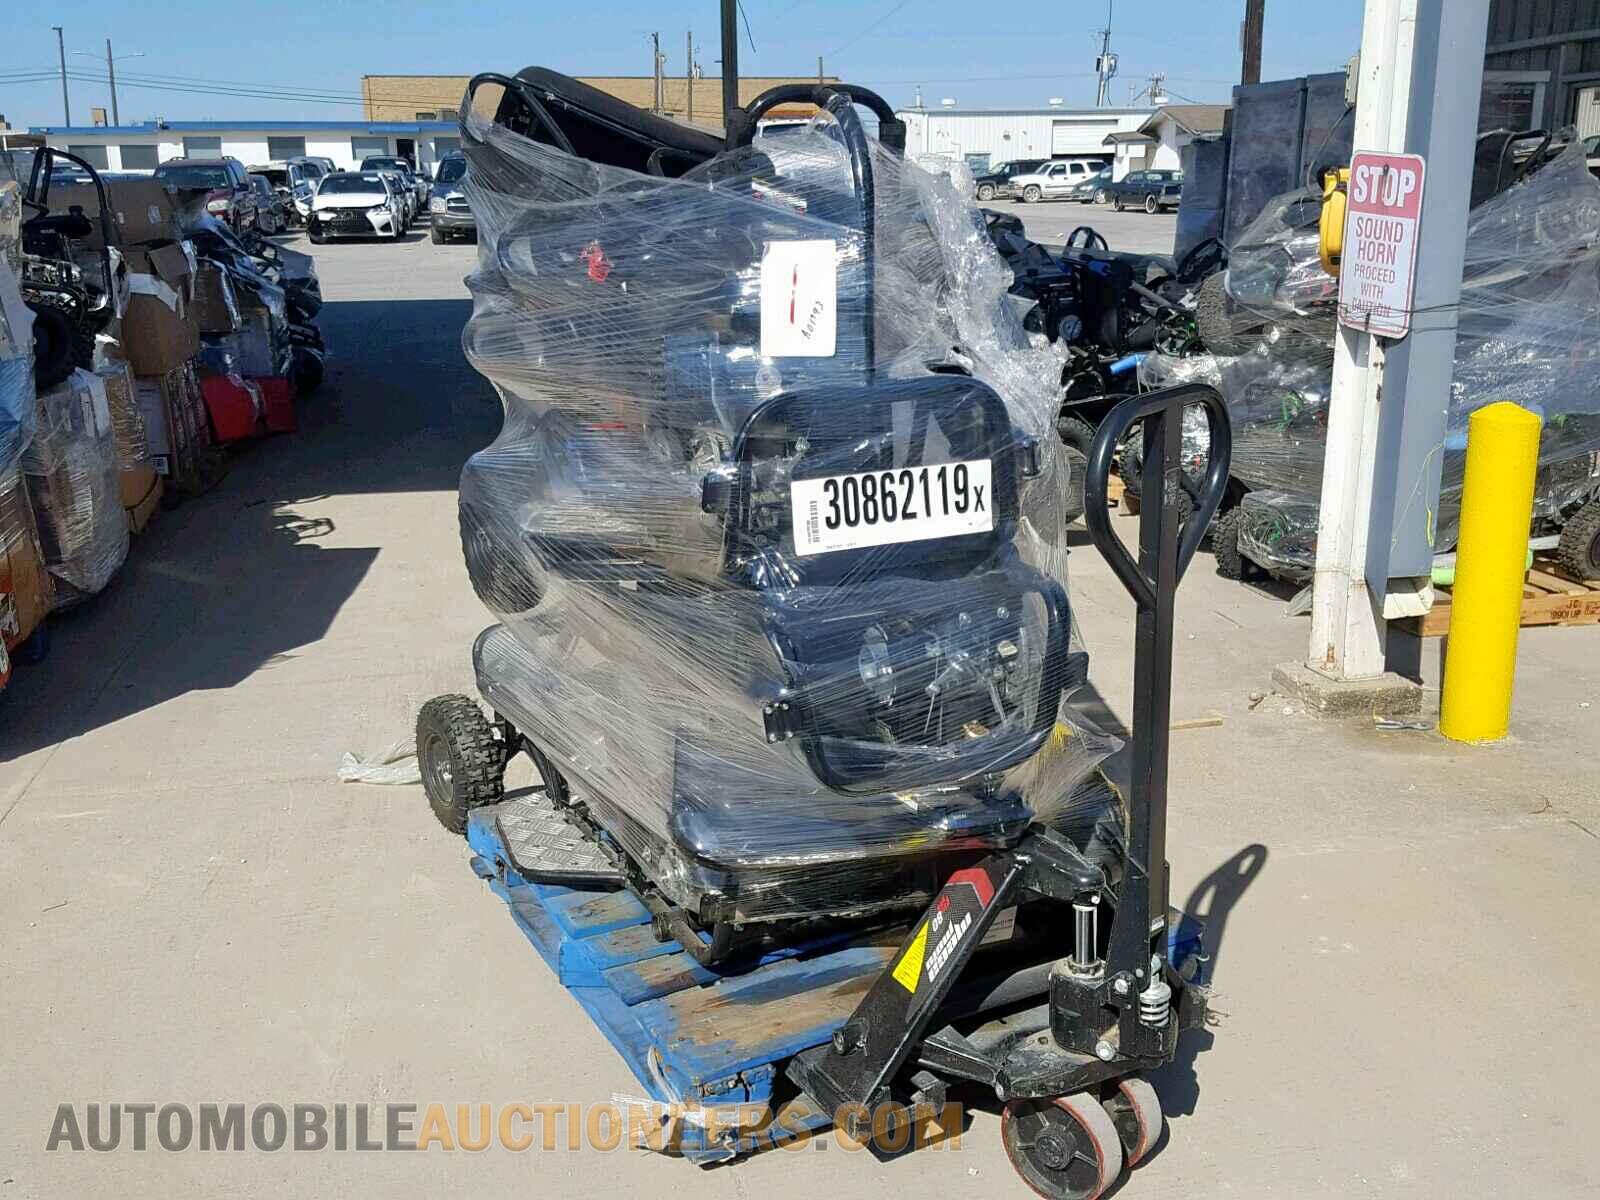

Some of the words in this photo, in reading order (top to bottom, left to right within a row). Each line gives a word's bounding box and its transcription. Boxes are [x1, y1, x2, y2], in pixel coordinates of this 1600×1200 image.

[1354, 164, 1416, 208] STOP
[1355, 217, 1404, 244] SOUND
[1357, 239, 1397, 266] HORN
[1354, 264, 1396, 284] PROCEED
[1360, 283, 1384, 299] WITH
[823, 463, 969, 530] 30862119
